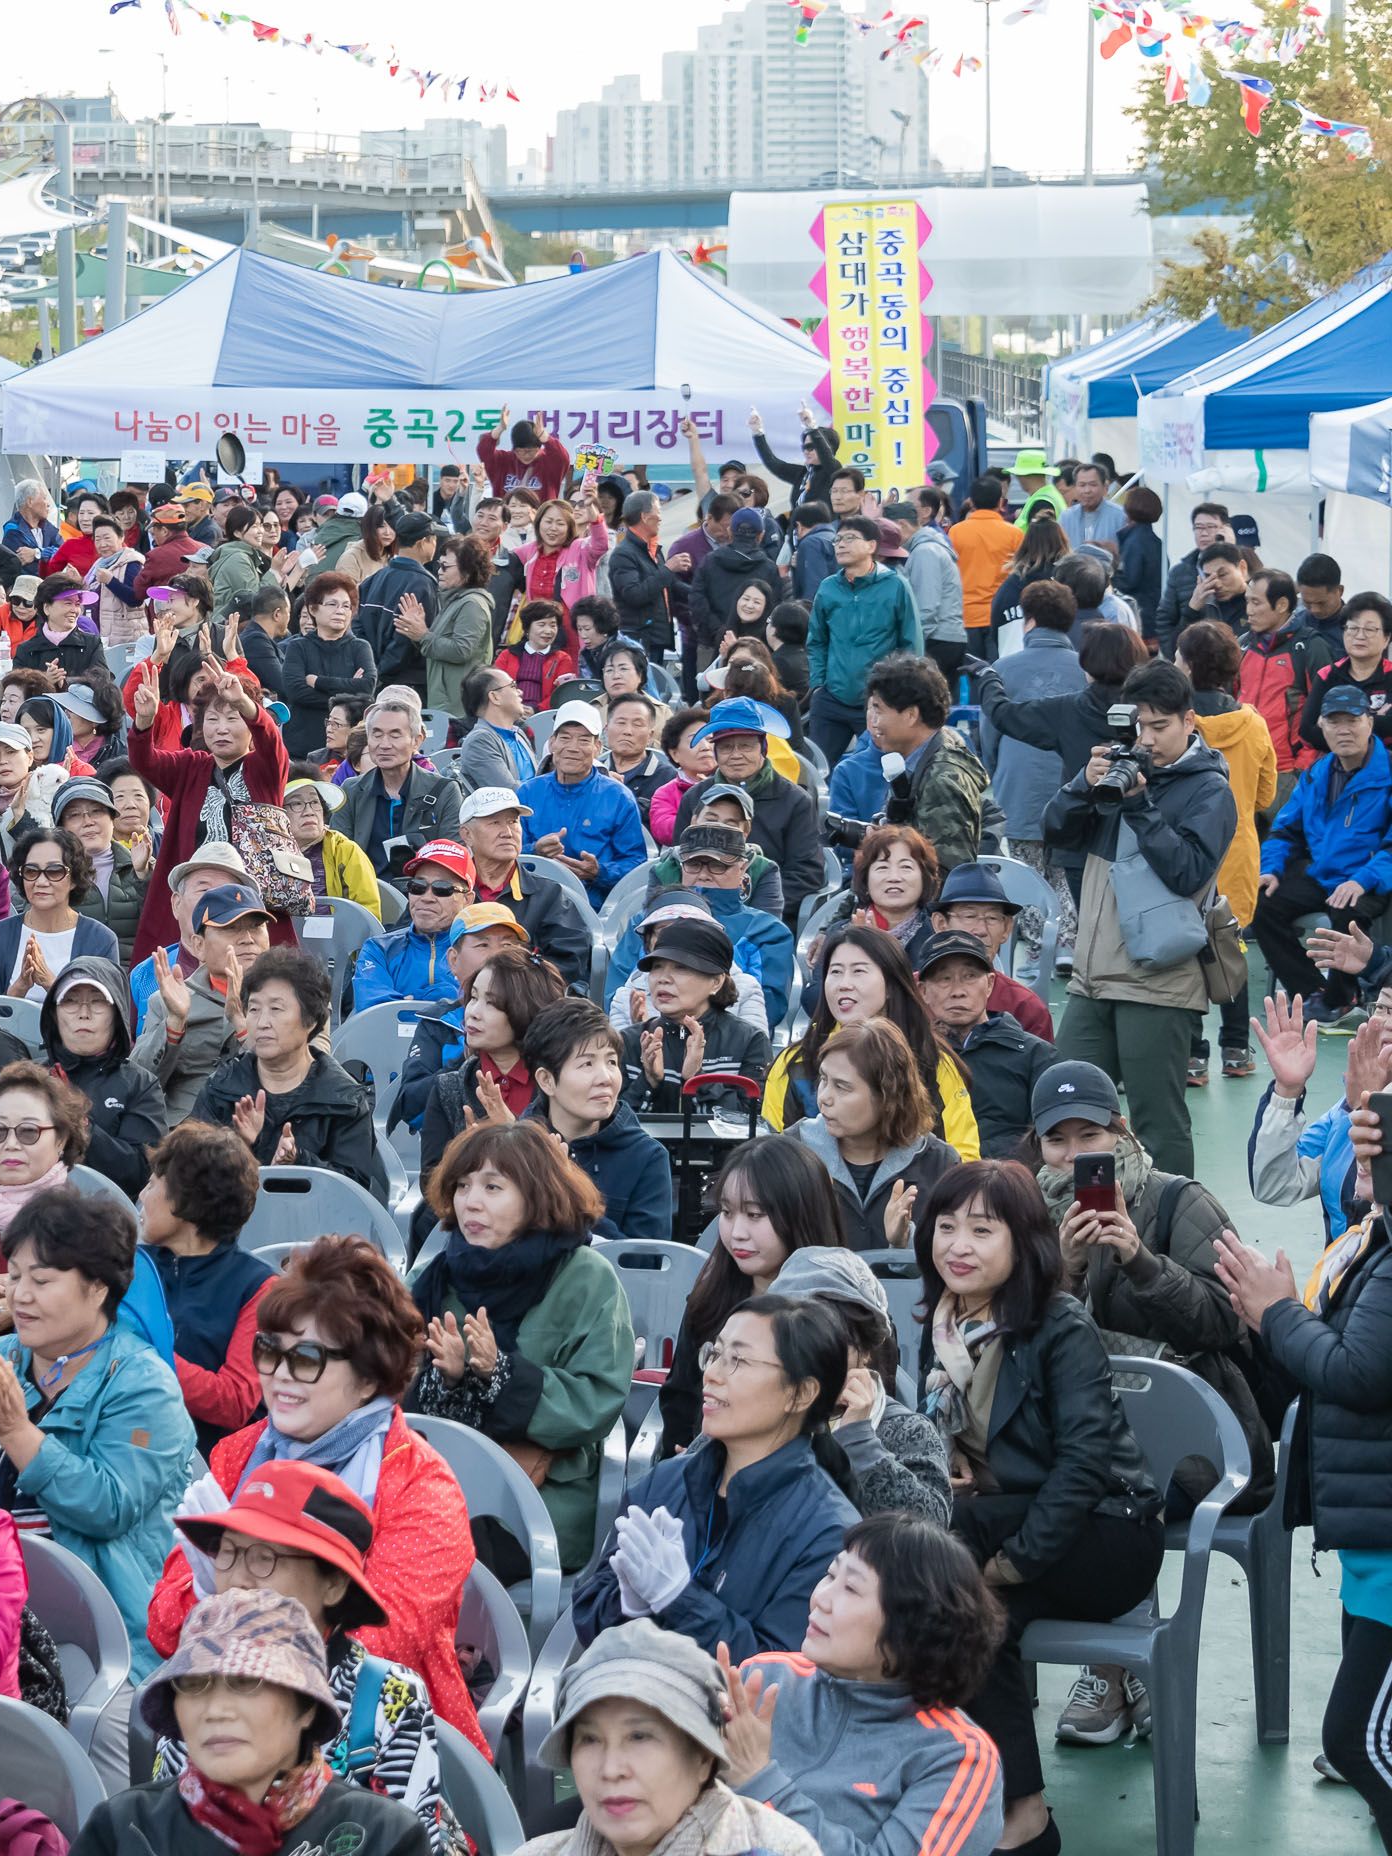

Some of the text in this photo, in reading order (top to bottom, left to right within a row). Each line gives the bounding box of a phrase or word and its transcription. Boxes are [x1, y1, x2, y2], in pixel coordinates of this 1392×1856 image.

[874, 229, 907, 351] 중곡동의
[836, 231, 876, 478] 삼대가 행복한 마을
[114, 410, 201, 443] 나눔이
[281, 413, 341, 447] 마을
[363, 408, 504, 449] 중곡2동
